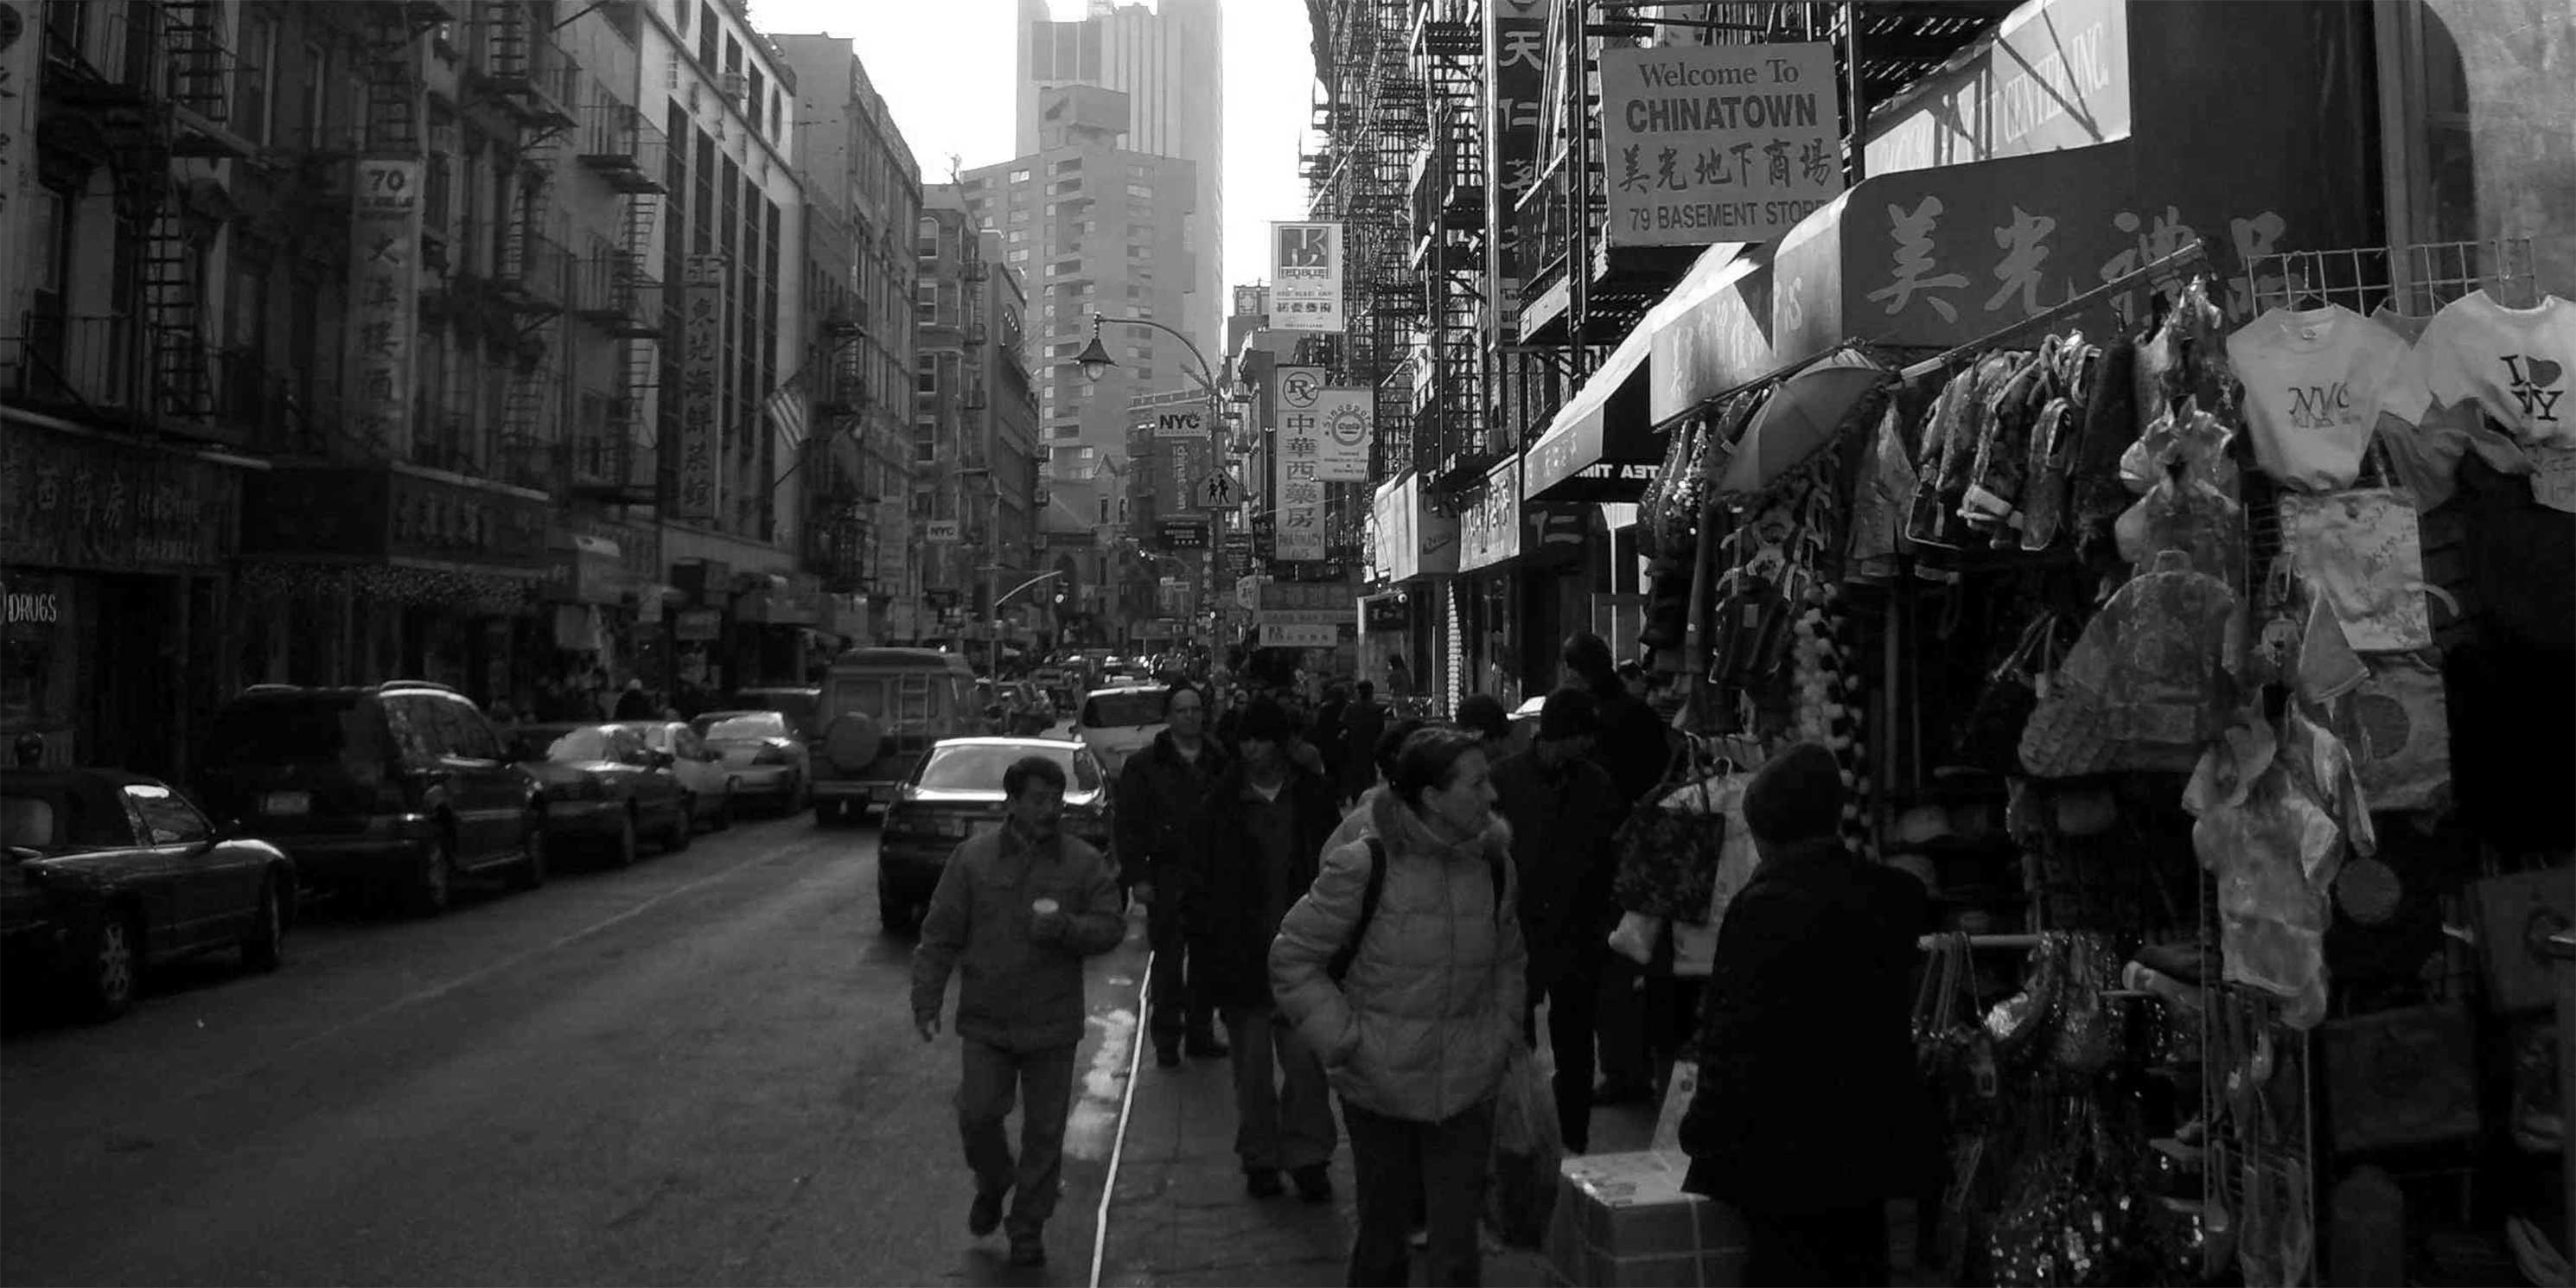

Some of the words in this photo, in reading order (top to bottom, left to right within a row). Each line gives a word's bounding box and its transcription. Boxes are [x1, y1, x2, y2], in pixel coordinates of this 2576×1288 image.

[1639, 62, 1757, 87] Welcome
[1766, 59, 1799, 83] To
[1625, 93, 1817, 133] CHINATOWN
[368, 170, 405, 191] 70
[1618, 138, 1831, 194] 美光地下商場
[1629, 207, 1651, 232] 79
[1657, 201, 1757, 230] BASEMENT
[2499, 354, 2525, 387] I
[1160, 413, 1201, 430] NYC
[1285, 413, 1317, 527] 中華西藥房
[931, 526, 954, 537] NYC
[9, 594, 57, 622] DRUGS
